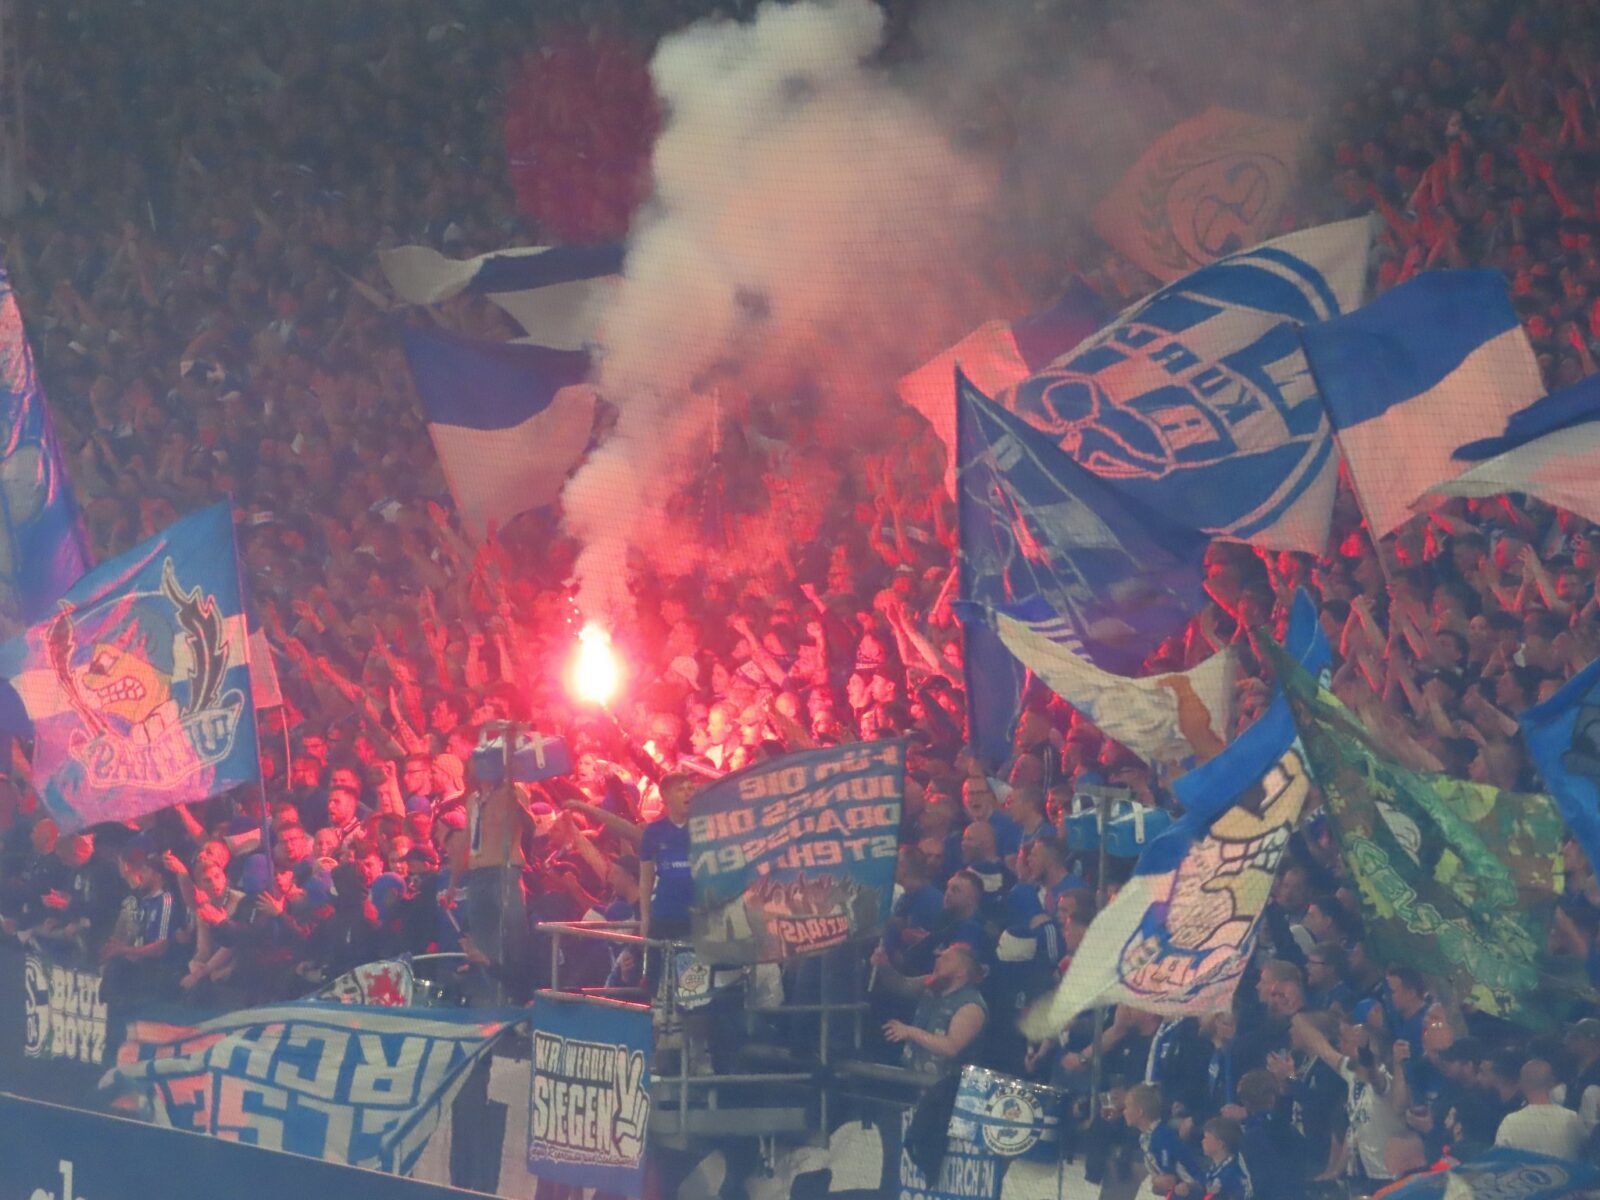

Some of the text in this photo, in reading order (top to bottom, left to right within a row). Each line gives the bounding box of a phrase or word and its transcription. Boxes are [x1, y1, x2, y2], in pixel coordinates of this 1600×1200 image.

[535, 1036, 615, 1083] WIR WERDEN
[533, 1074, 614, 1154] SIEGEN
